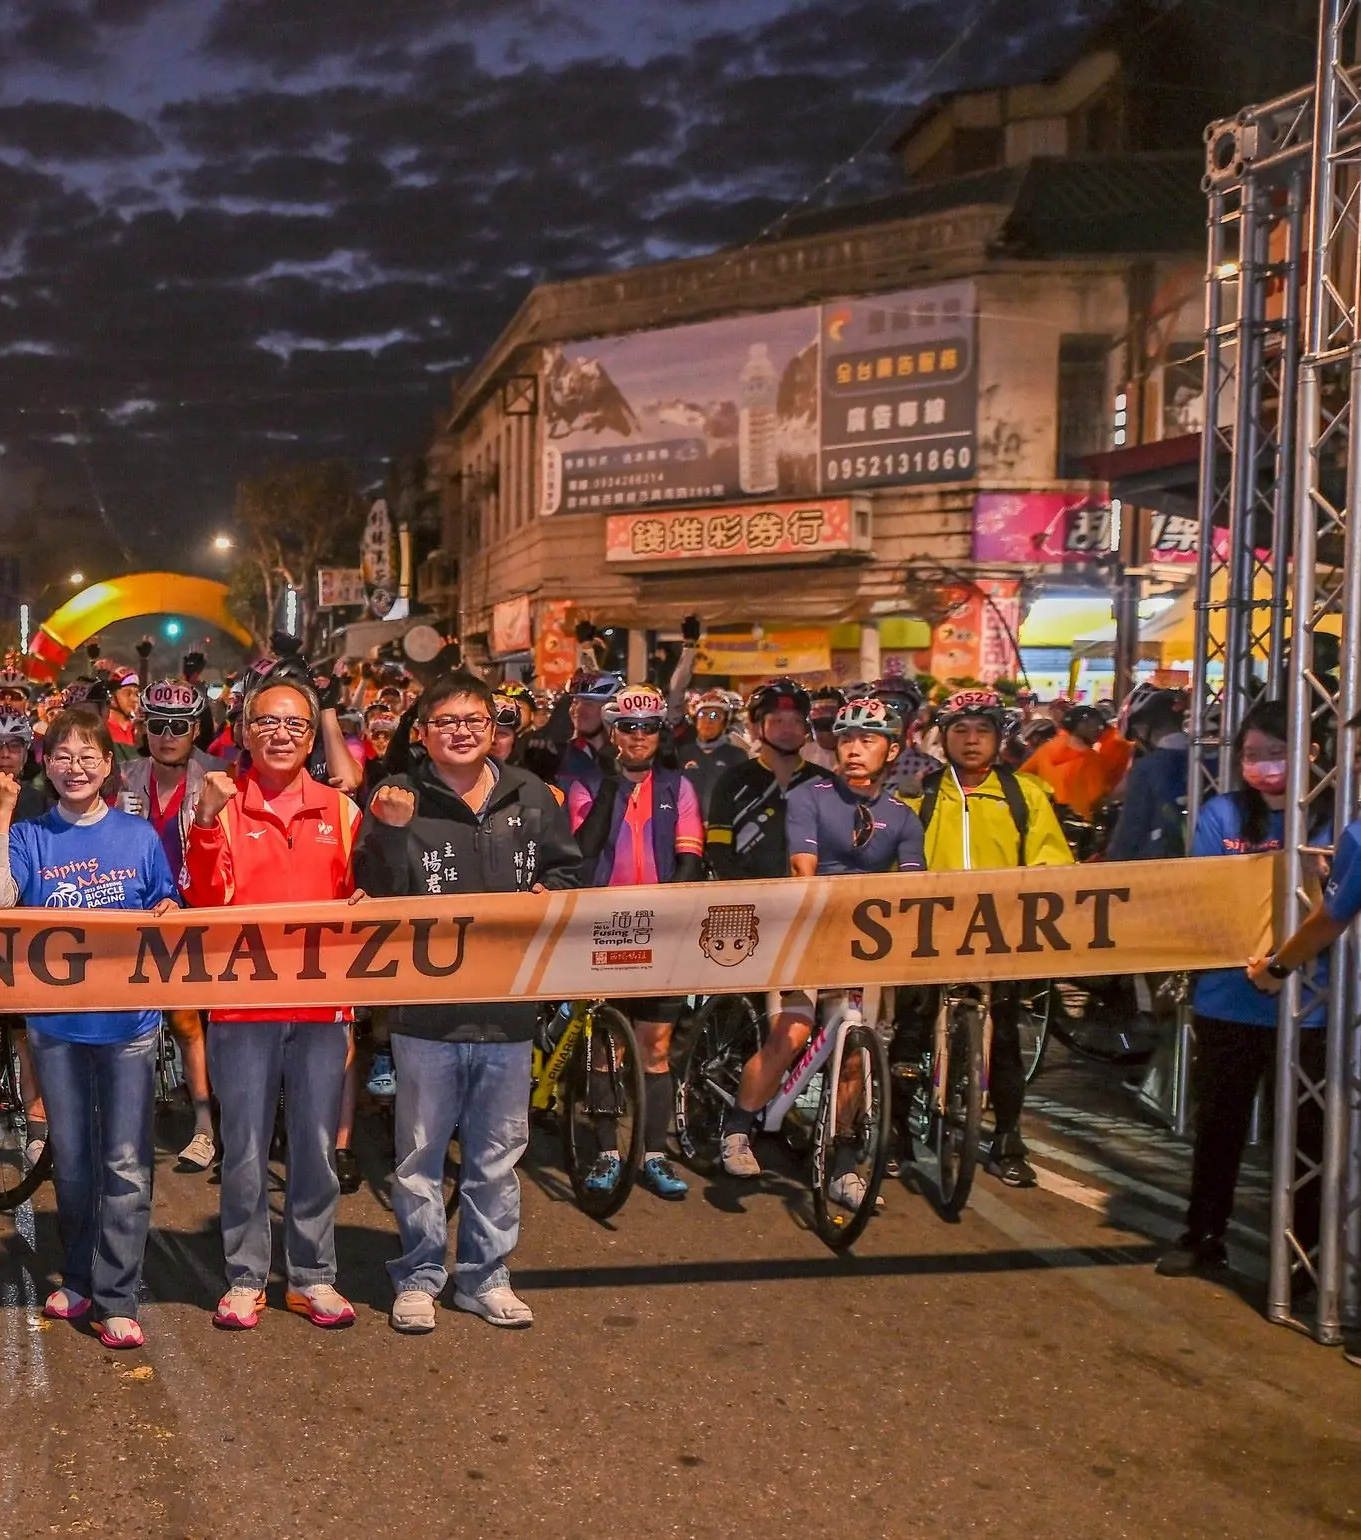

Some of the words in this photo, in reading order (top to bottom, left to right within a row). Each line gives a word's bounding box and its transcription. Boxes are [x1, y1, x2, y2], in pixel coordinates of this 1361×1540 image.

[827, 447, 971, 481] 0952131860
[631, 509, 824, 554] 錢堆彩券行
[154, 687, 190, 705] 0016
[956, 692, 992, 706] 0527
[444, 842, 459, 881] 主任
[78, 868, 136, 889] Matzu
[85, 886, 125, 901] BICYCLE
[87, 894, 126, 908] RACING
[850, 887, 1131, 961] START
[593, 930, 629, 938] Fusing
[593, 938, 633, 946] Temple
[128, 916, 475, 983] MATZU
